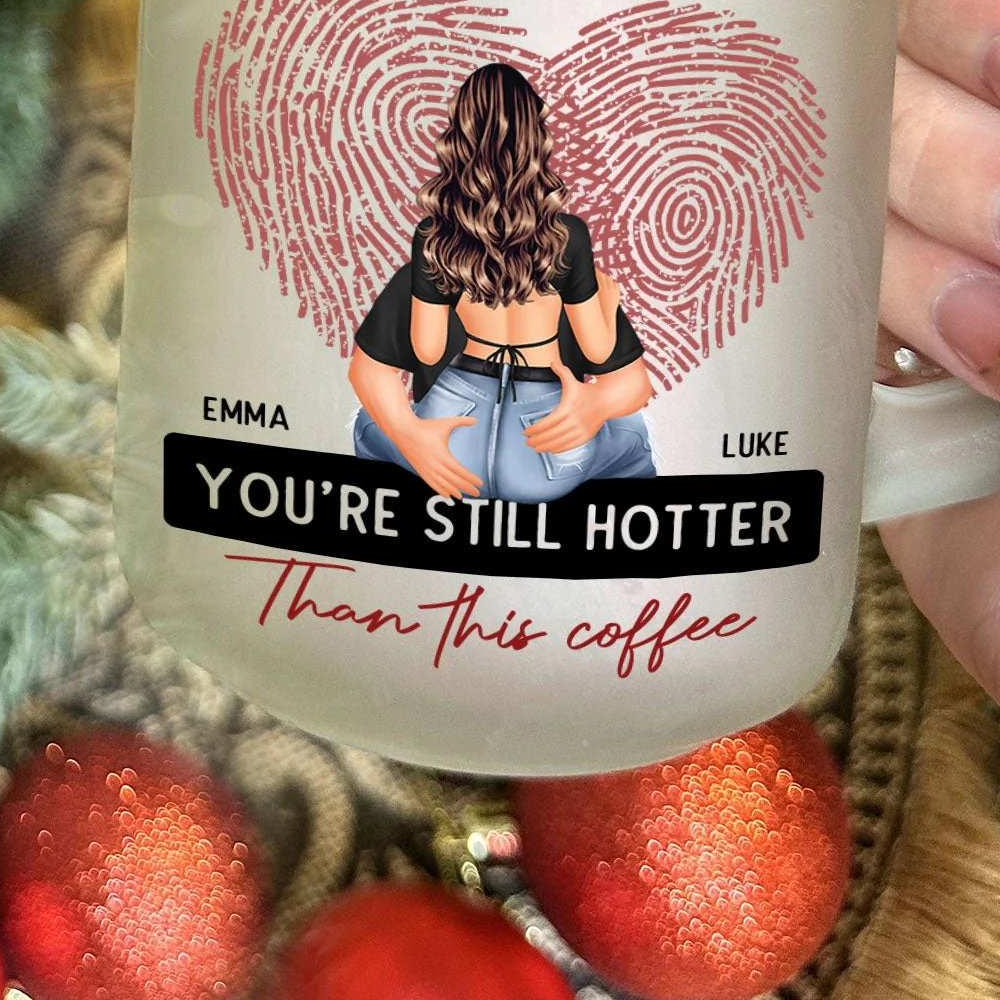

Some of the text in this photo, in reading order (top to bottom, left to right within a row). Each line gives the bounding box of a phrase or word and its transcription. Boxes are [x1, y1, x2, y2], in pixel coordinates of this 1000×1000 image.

[203, 396, 289, 431] EMMA
[721, 430, 789, 458] LUKE
[423, 494, 562, 550] STILL
[585, 500, 792, 551] HOTTER
[225, 554, 758, 679] Than this coffee
